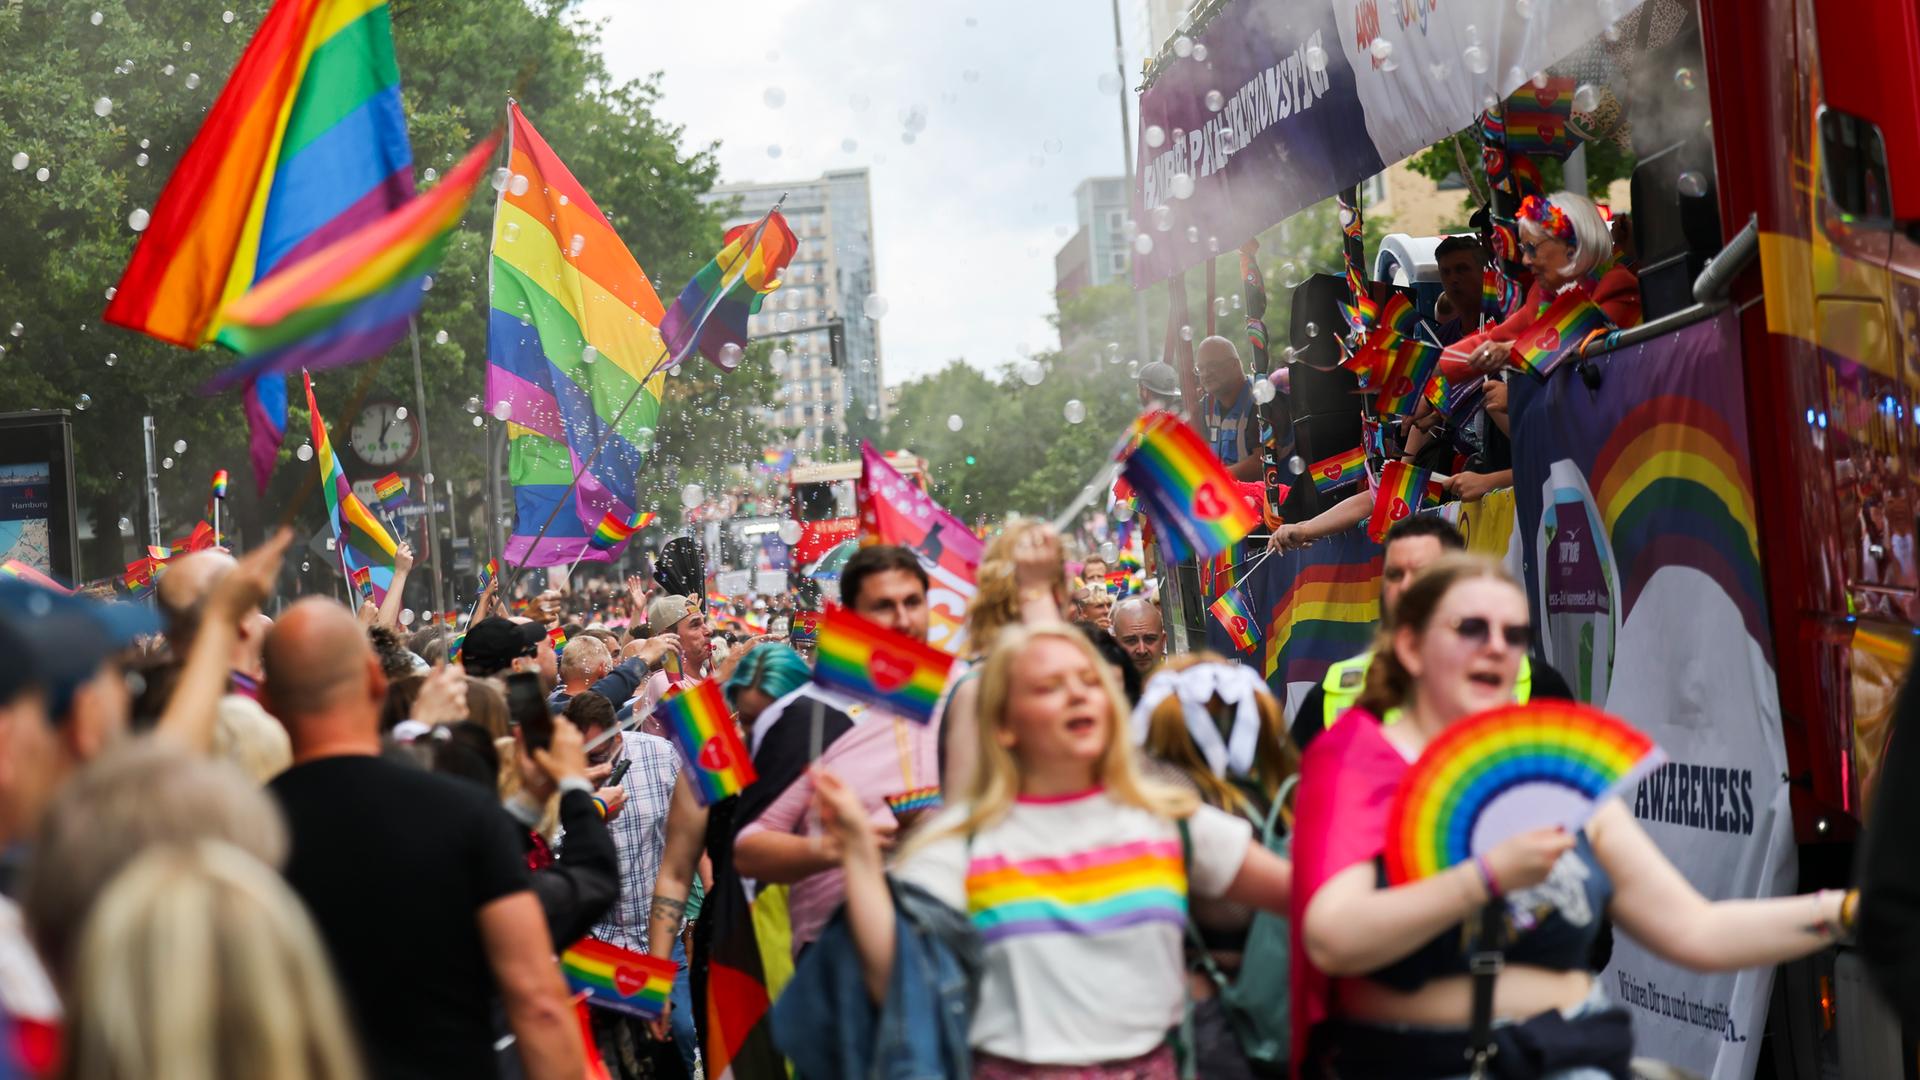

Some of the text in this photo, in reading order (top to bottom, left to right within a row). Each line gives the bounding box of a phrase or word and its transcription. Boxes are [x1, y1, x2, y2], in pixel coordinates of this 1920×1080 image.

[11, 502, 48, 510] Hamburg
[1635, 762, 1754, 836] AWARENESS
[1671, 991, 1688, 1022] und
